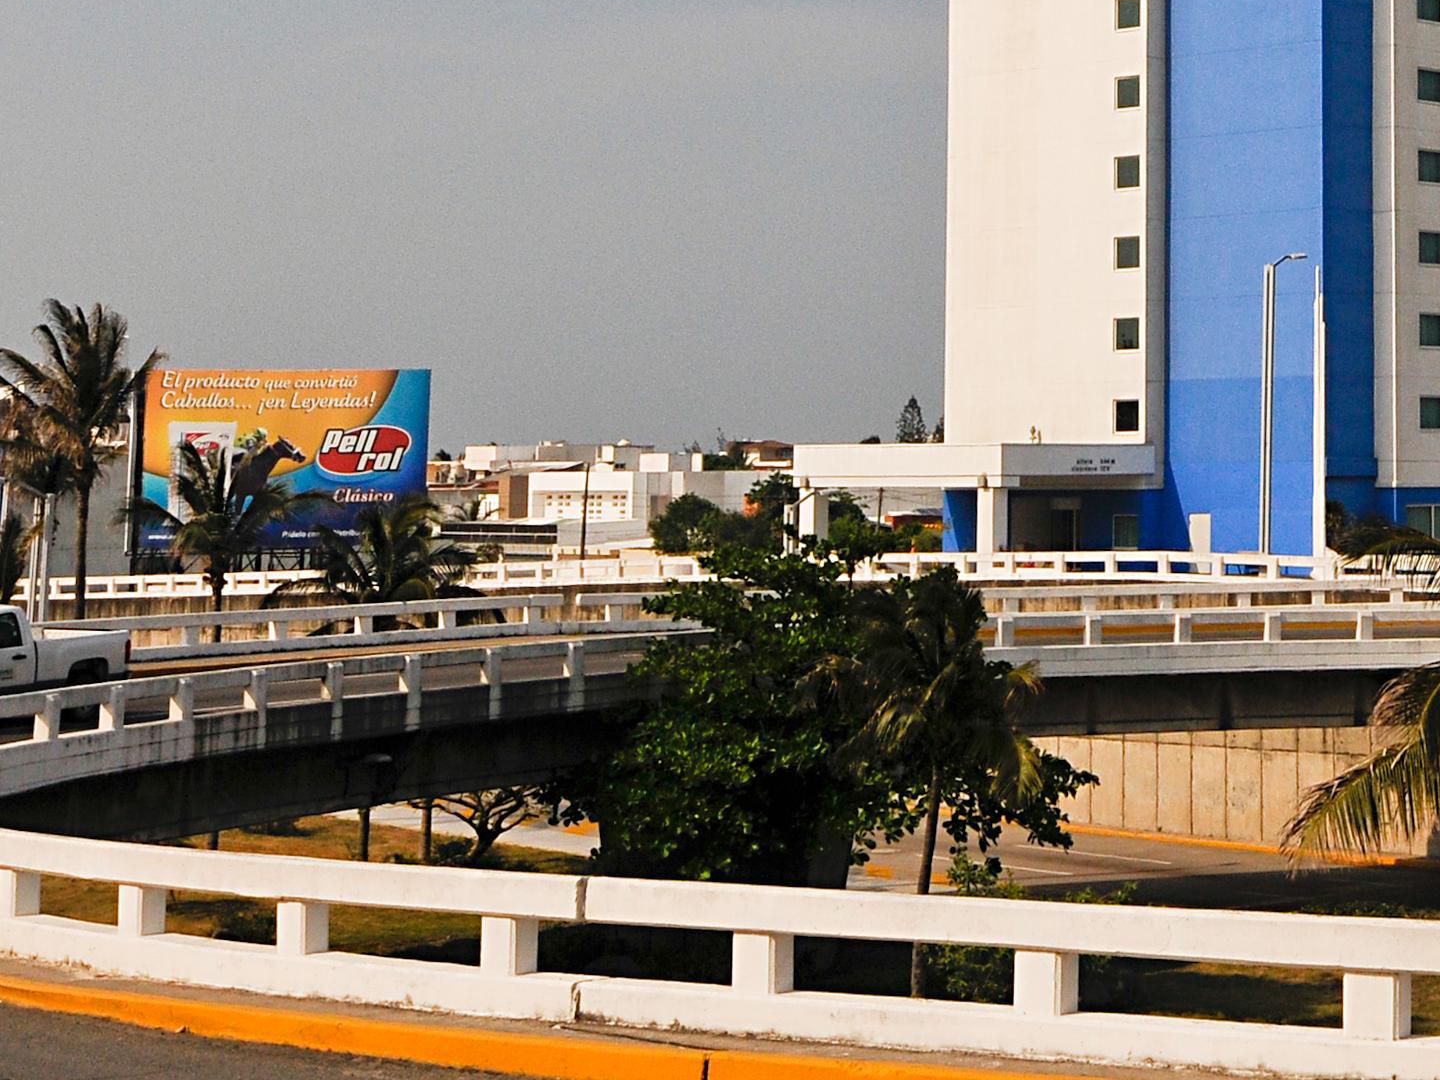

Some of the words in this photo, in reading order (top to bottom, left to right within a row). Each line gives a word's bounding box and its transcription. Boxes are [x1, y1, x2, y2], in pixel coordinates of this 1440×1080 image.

[162, 370, 181, 389] El
[182, 373, 261, 393] producto
[264, 377, 291, 393] que
[294, 375, 358, 390] convirtió
[257, 396, 287, 415] ¡en
[290, 390, 378, 414] Leyendas!
[356, 446, 405, 471] rol
[332, 487, 394, 504] Clásico
